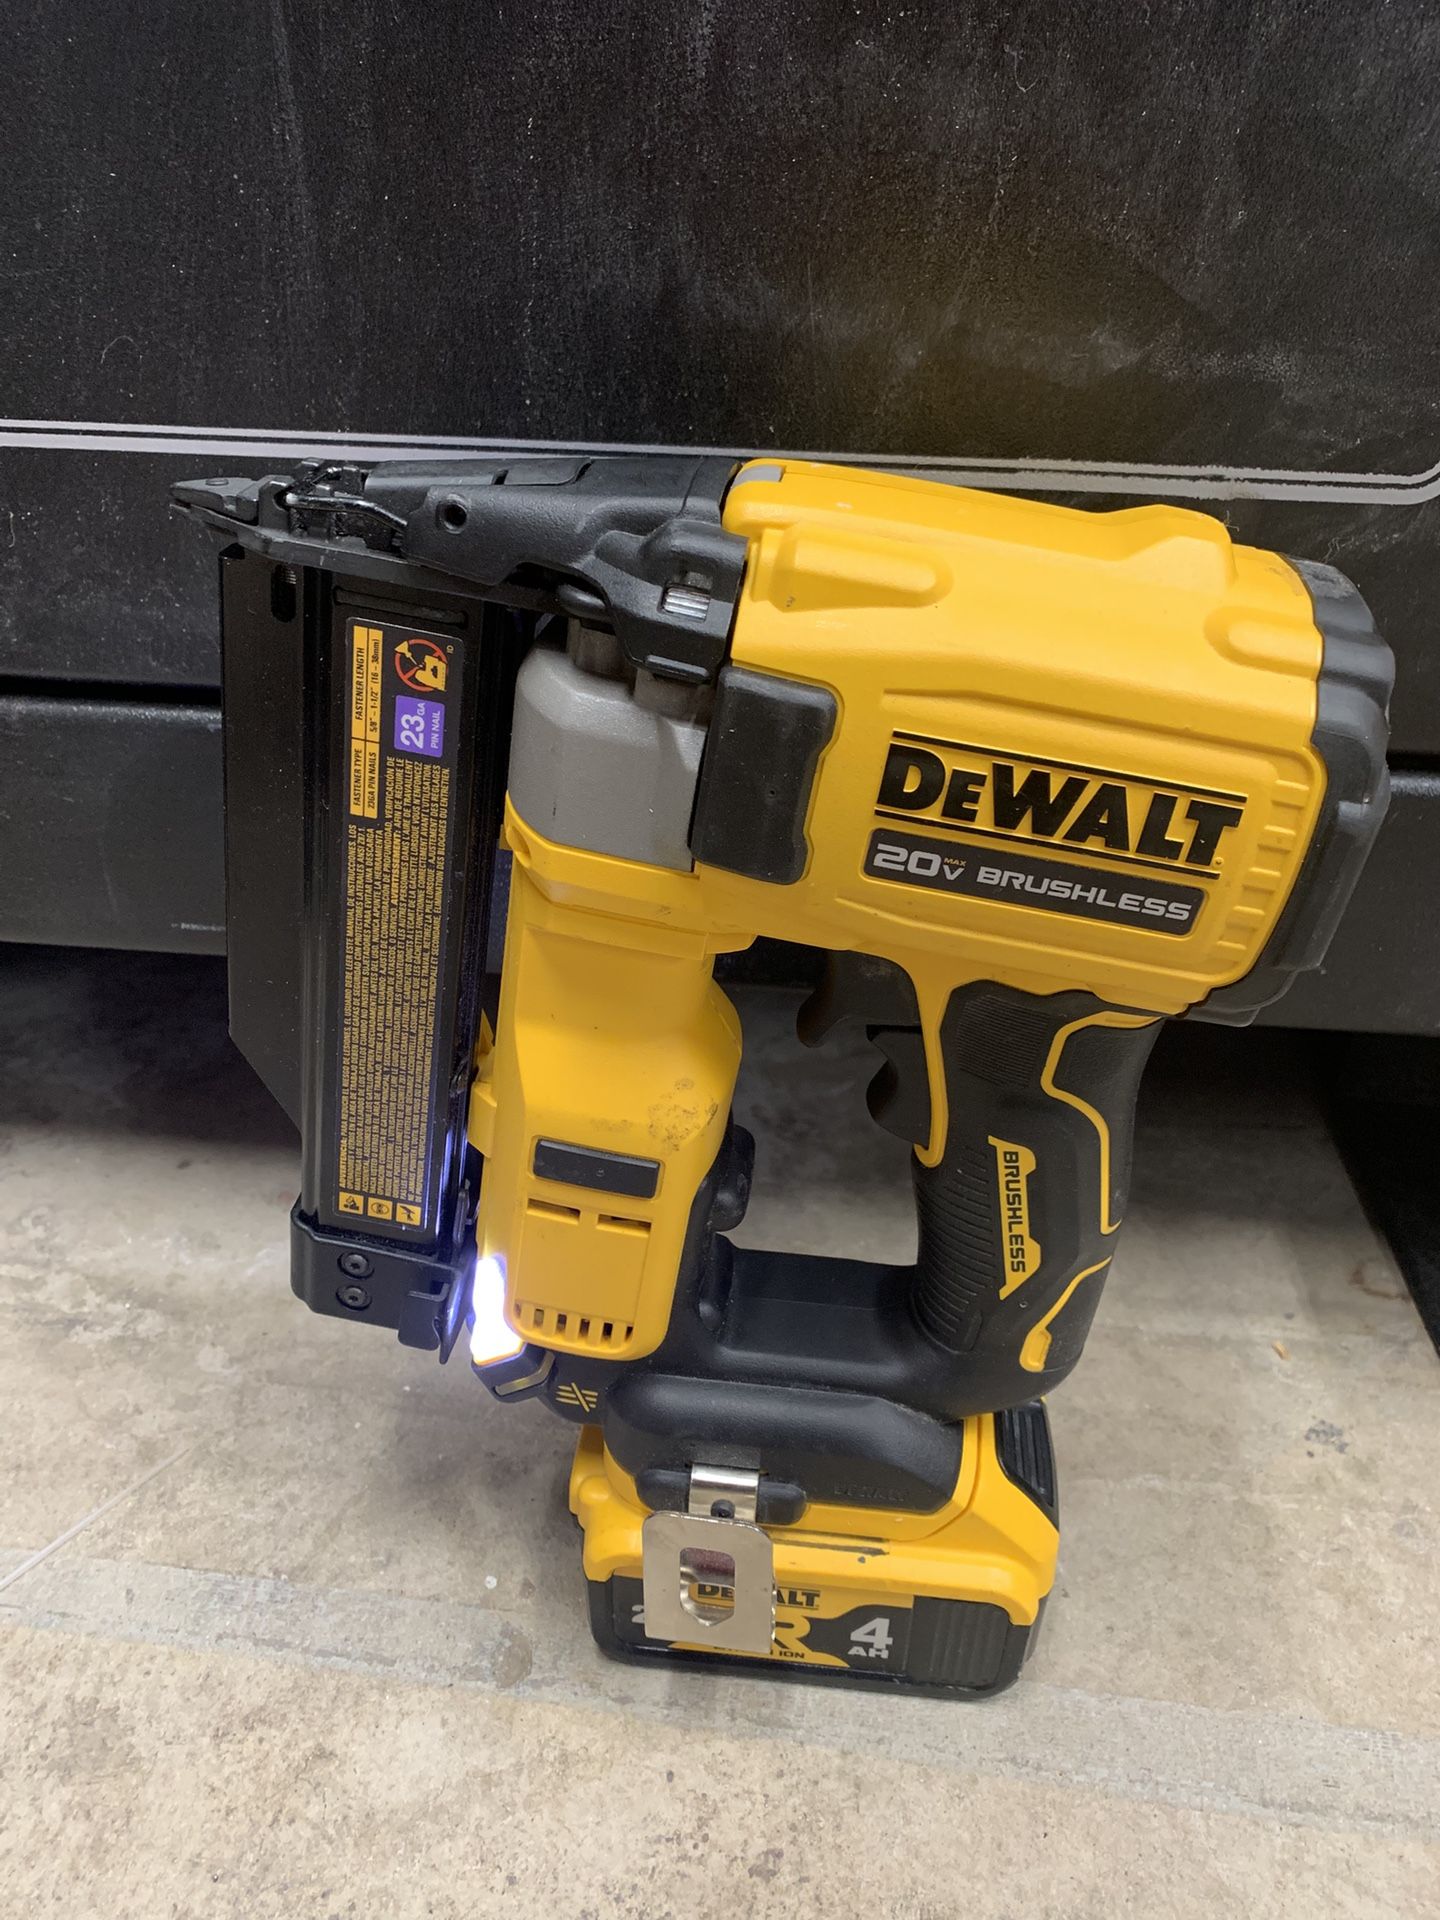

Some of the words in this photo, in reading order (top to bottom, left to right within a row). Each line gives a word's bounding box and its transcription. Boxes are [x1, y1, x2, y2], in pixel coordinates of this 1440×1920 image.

[355, 646, 364, 679] LENGTH
[354, 679, 364, 720] FASTENER
[431, 709, 440, 731] NAIL
[430, 731, 439, 749] PIN
[353, 748, 362, 766] TYPE
[368, 751, 376, 775] NAILS
[352, 766, 362, 806] FASTENER
[367, 775, 376, 789] PIN
[367, 789, 375, 809] 23GA
[876, 742, 1244, 867] DEWALT
[393, 810, 401, 828] AFIN
[356, 844, 364, 862] ANSI
[365, 827, 374, 866] DESCARGA
[373, 829, 383, 880] HERRAMIENTA
[355, 863, 364, 900] LATERALES
[976, 865, 1193, 922] BRUSHLESS
[363, 883, 372, 908] EVITAR
[372, 890, 380, 917] APUNTE
[345, 907, 354, 937] MANUAL
[354, 900, 363, 945] PROTECTORES
[363, 909, 371, 928] PARA
[371, 918, 379, 943] NUNCA
[345, 937, 353, 953] ESTE
[361, 928, 370, 975] SUJETADORES
[378, 949, 387, 974] AJUSTE
[344, 970, 352, 988] DEBE
[352, 960, 361, 997] SEGURIDAD
[369, 972, 377, 993] ANTES
[360, 976, 369, 1008] INSERTEN
[1003, 1150, 1026, 1273] BRUSHLESS
[850, 1616, 893, 1649] 4
[847, 1645, 889, 1659] AH
